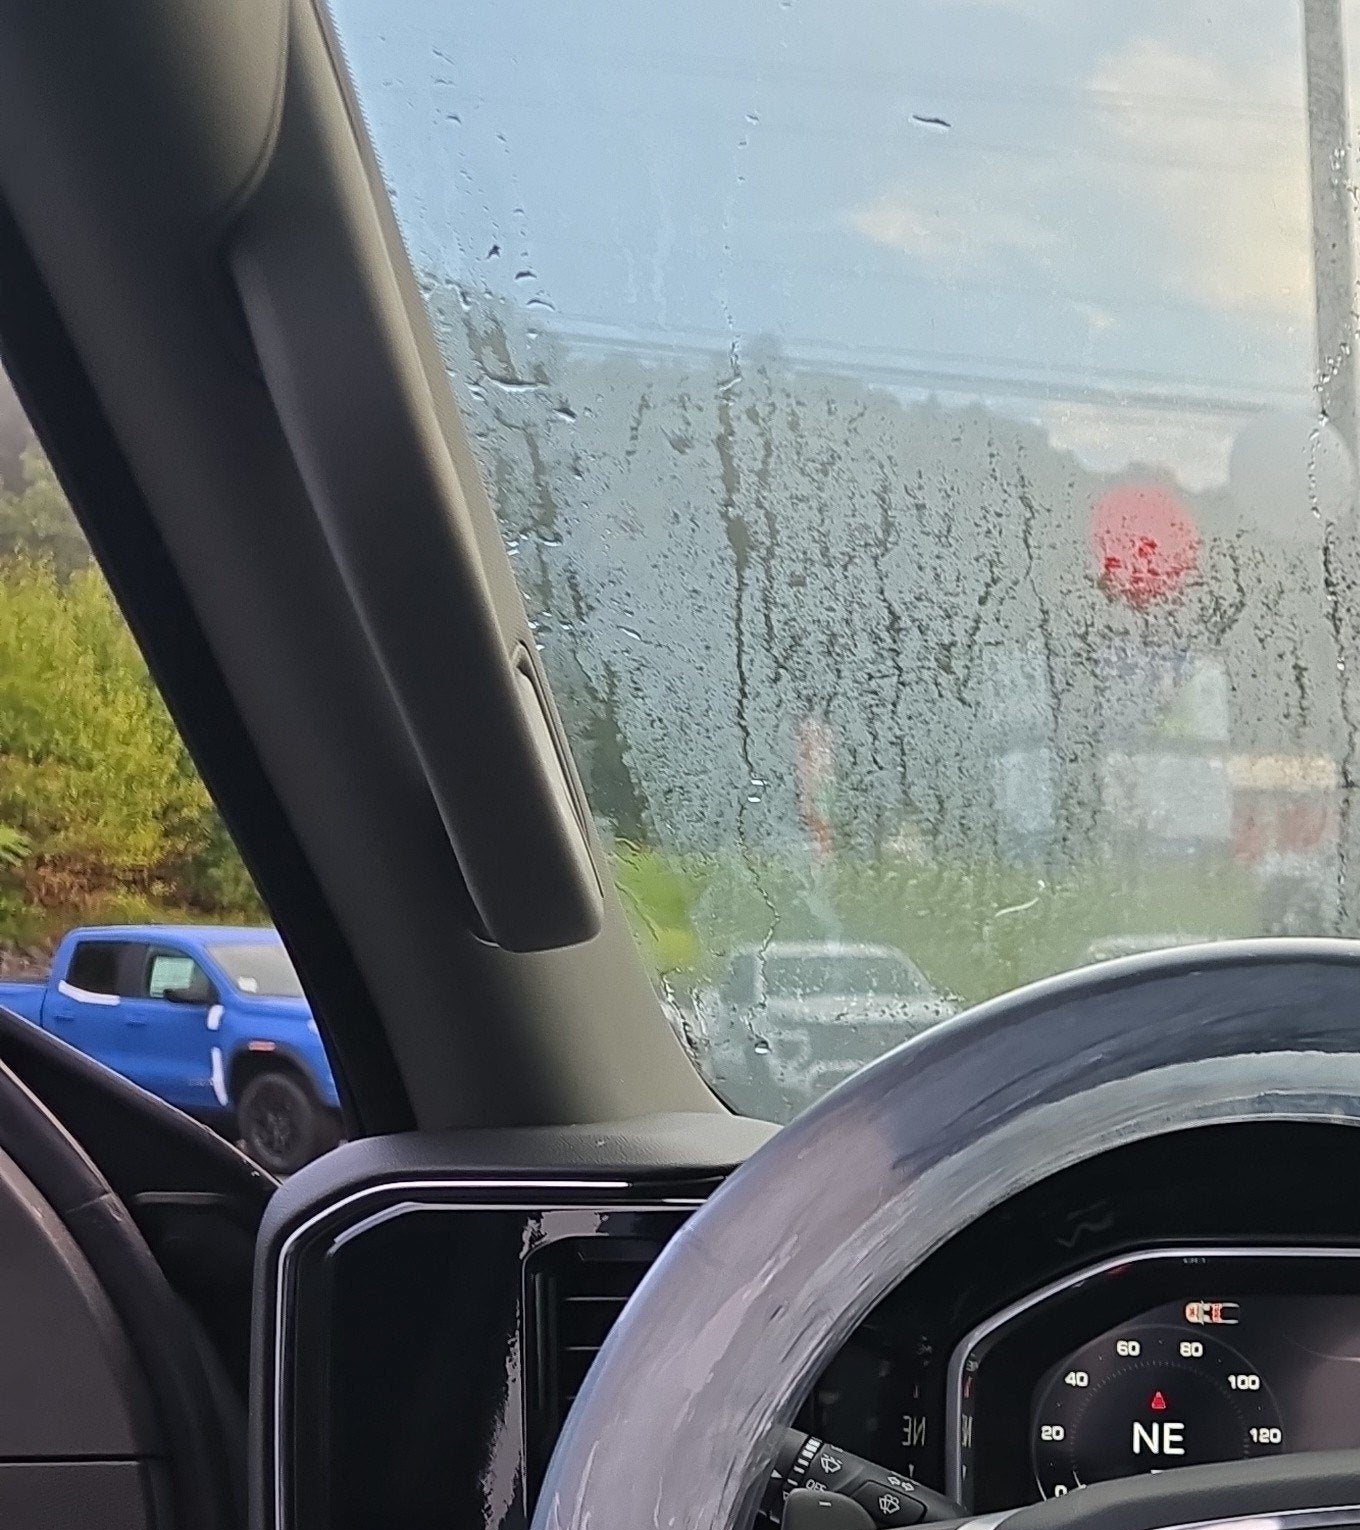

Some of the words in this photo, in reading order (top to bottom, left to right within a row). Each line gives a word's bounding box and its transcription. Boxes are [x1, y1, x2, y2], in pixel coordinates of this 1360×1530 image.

[1116, 1341, 1141, 1357] 60
[1180, 1341, 1204, 1358] 80
[1064, 1371, 1089, 1388] 40
[1228, 1374, 1261, 1391] 100
[1041, 1425, 1065, 1441] 20
[1132, 1421, 1185, 1455] NE
[1249, 1428, 1282, 1444] 120
